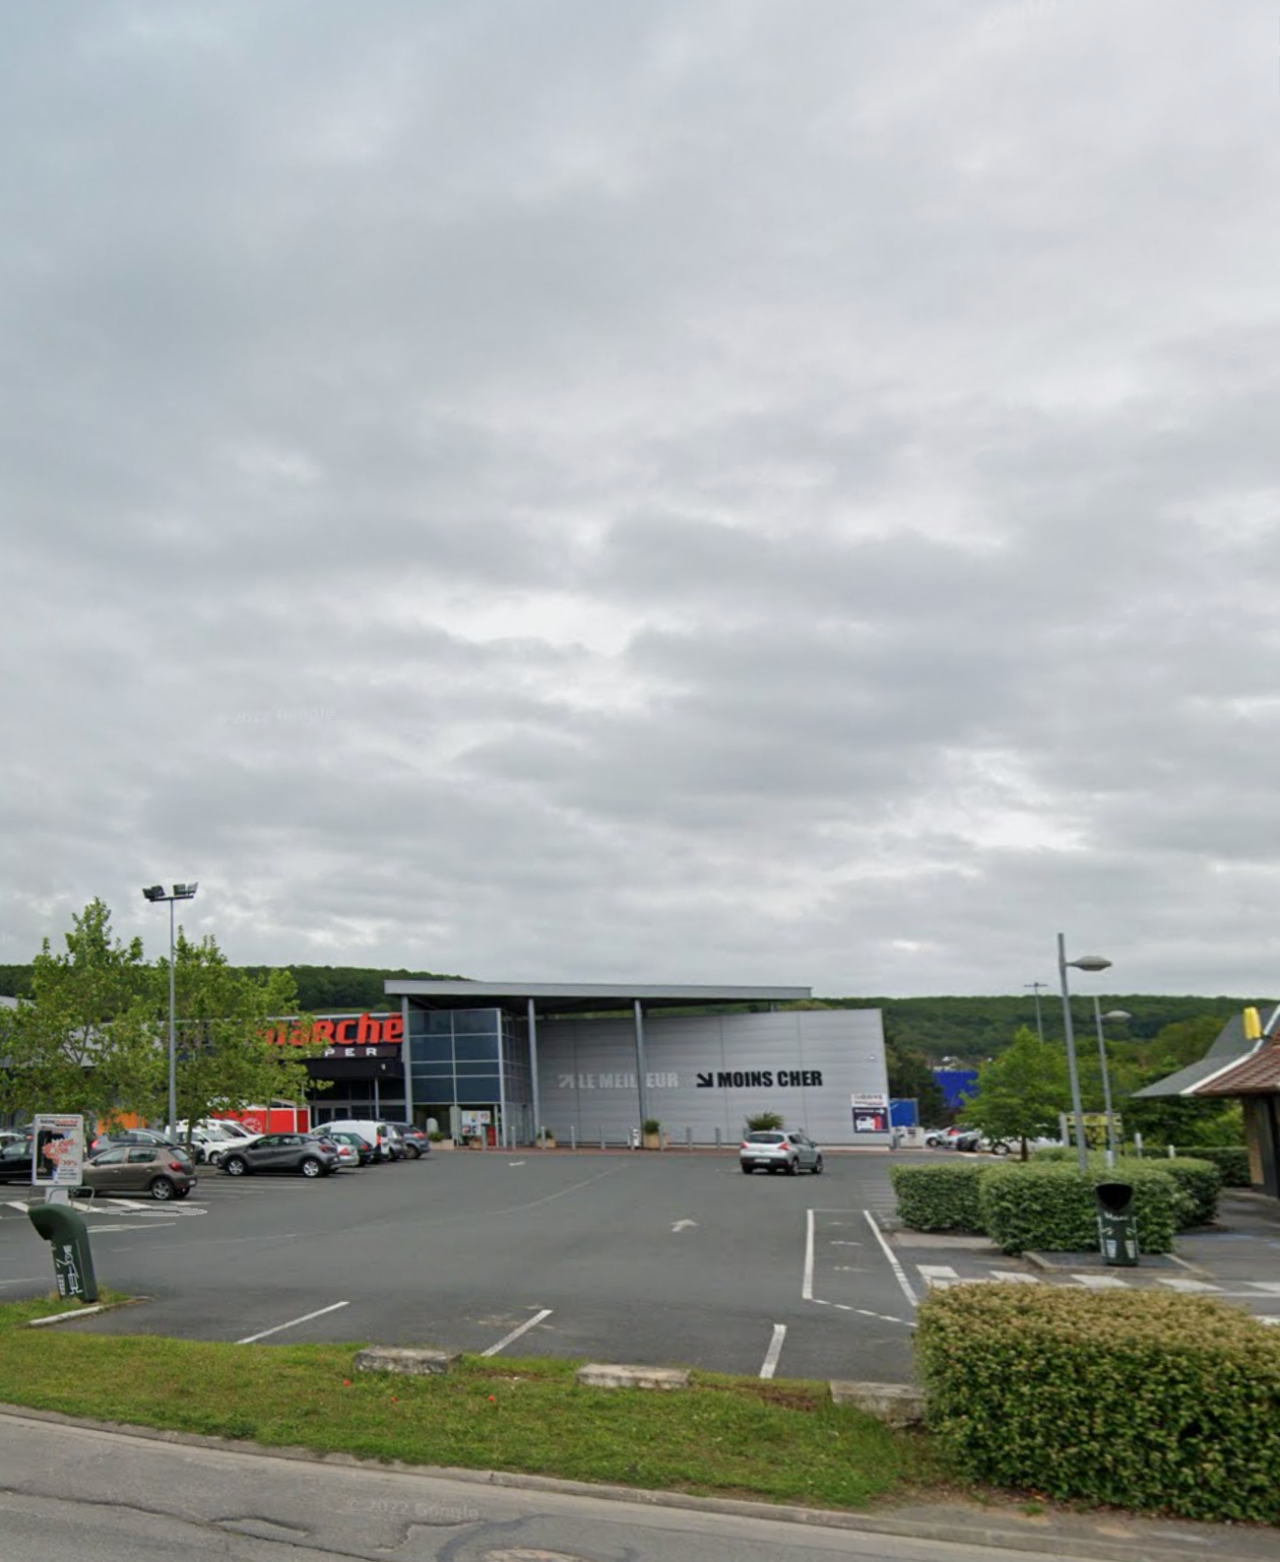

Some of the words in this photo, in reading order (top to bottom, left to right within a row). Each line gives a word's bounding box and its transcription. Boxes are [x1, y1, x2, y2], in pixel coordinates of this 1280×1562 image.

[579, 1073, 595, 1089] LE
[599, 1072, 679, 1089] MEILEUR
[717, 1071, 773, 1088] MOINS
[777, 1070, 823, 1087] CHER
